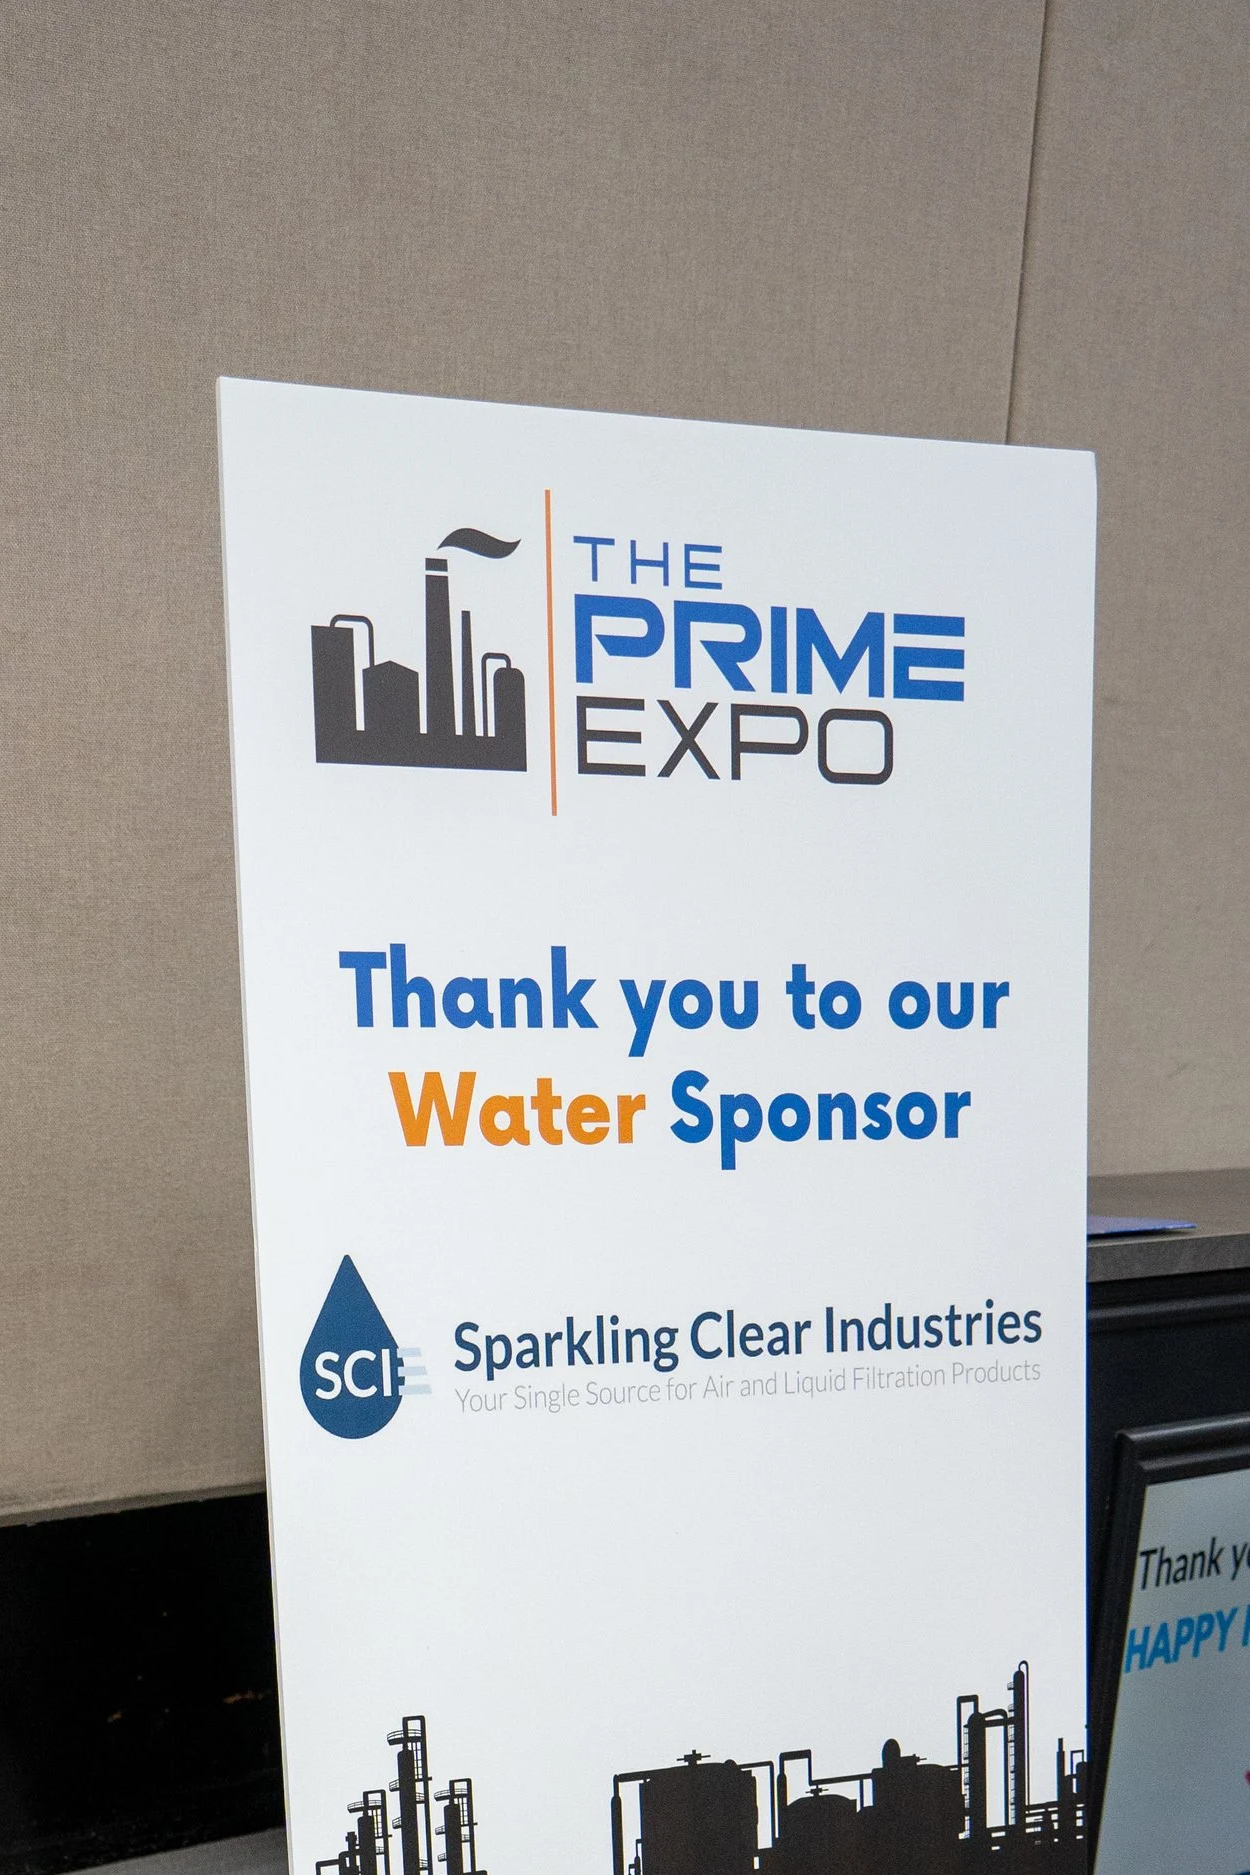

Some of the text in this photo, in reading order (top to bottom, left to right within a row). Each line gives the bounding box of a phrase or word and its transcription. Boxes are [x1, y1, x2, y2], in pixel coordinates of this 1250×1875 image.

[574, 535, 723, 590] THE
[575, 594, 965, 701] PRIME
[577, 695, 894, 785] EXPO
[339, 943, 1010, 1058] Thank you to our
[388, 1069, 972, 1171] Water Sponsor
[314, 1347, 393, 1401] SCI
[454, 1298, 1043, 1381] Sparkling Clear Industries
[454, 1358, 1043, 1414] Your Single Source for Air and Liquid Filtration Products
[1139, 1536, 1225, 1591] Thank
[1123, 1606, 1238, 1674] HAPPY
